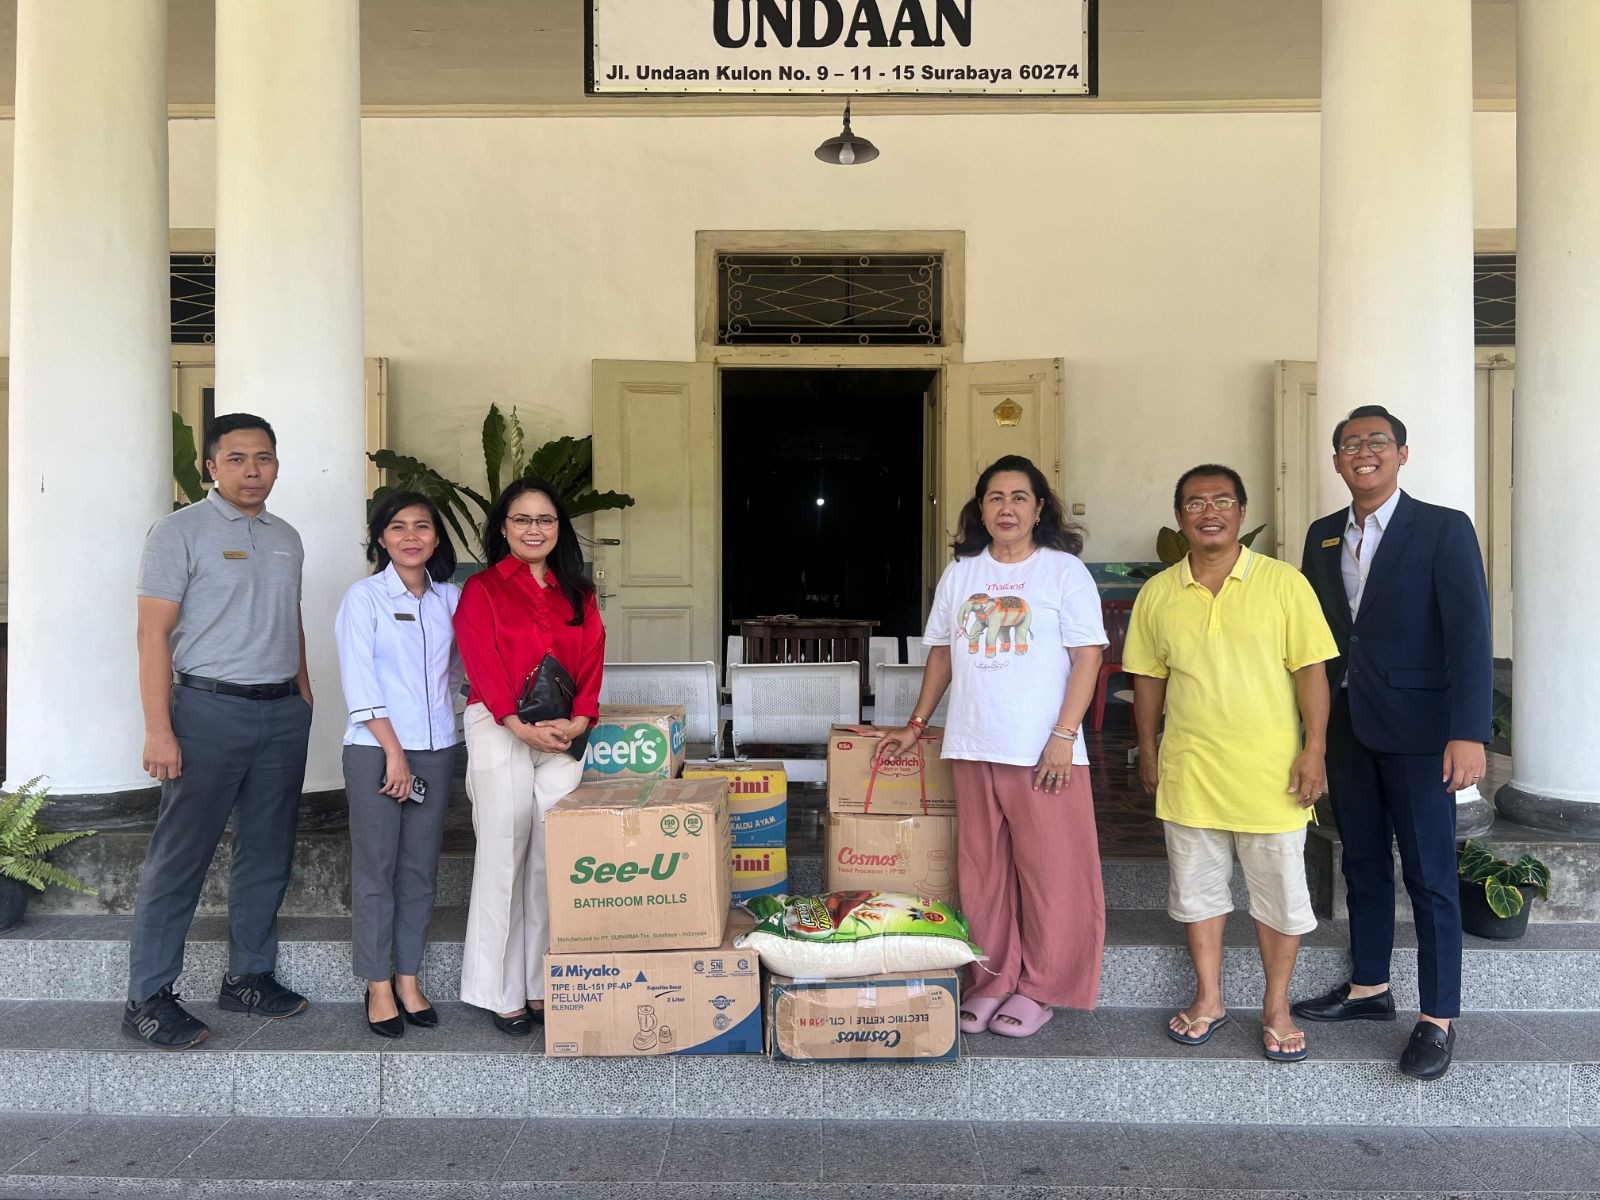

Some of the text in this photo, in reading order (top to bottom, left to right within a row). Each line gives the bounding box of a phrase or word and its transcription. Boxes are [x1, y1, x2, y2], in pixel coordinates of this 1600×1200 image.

[713, 0, 972, 48] UNDAAN
[606, 65, 629, 80] Jl.
[636, 65, 710, 80] Undaan
[716, 65, 772, 81] Kulon
[778, 65, 811, 81] No.
[816, 66, 829, 81] 9
[850, 65, 872, 80] 11
[891, 65, 915, 80] 15
[921, 64, 1012, 83] Surabaya
[1019, 64, 1079, 79] 60274
[838, 847, 897, 866] Cosmos
[570, 852, 681, 885] See-U
[574, 893, 688, 909] BATHROOM ROLLS
[566, 965, 620, 980] Miyako
[577, 983, 605, 991] BL-151
[607, 982, 633, 990] PF-AP
[551, 993, 604, 1003] PELUMAT
[856, 1016, 886, 1025] KETTLE
[888, 1013, 929, 1024] ELECTRIC
[836, 1029, 900, 1048] Cosmos
